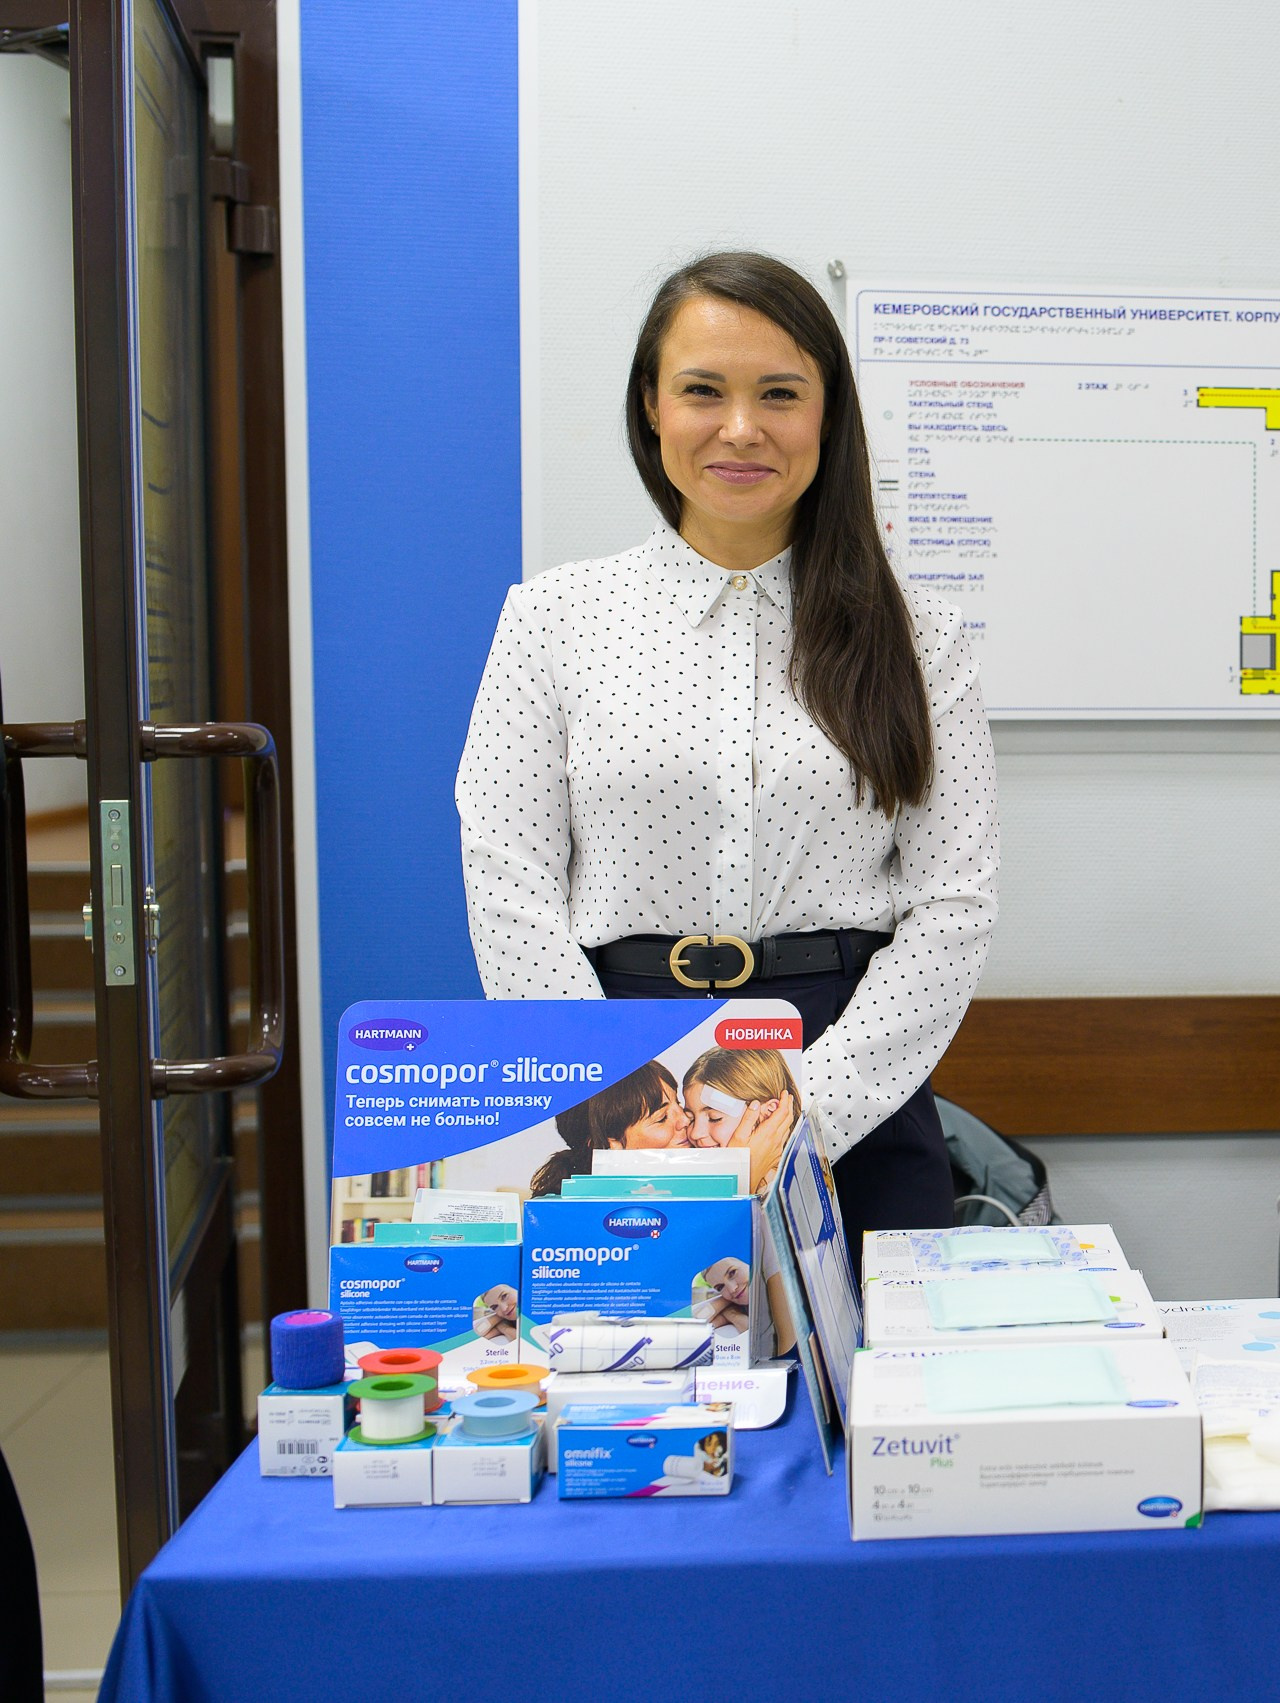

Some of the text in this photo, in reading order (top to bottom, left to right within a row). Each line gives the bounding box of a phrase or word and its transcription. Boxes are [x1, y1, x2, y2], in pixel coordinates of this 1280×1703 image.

[874, 303, 979, 316] КЕМЕРОВСКИЙ
[984, 305, 1126, 319] ГОСУДАРСТВЕННЫЙ
[1130, 309, 1232, 322] УНИВЕРСИТЕТ.
[896, 335, 947, 344] СОВЕТСКИЙ
[356, 1028, 422, 1039] HARTMANN
[725, 1028, 793, 1041] НОВИНКА
[502, 1057, 602, 1083] silicone
[346, 1094, 552, 1112] Теперь снимать повязку
[344, 1111, 500, 1127] совсем не больно!
[609, 1218, 661, 1227] HARTMANN
[531, 1266, 580, 1279] silicone
[340, 1290, 370, 1298] silicone
[715, 1344, 741, 1352] Sterile
[930, 1457, 954, 1468] Plus
